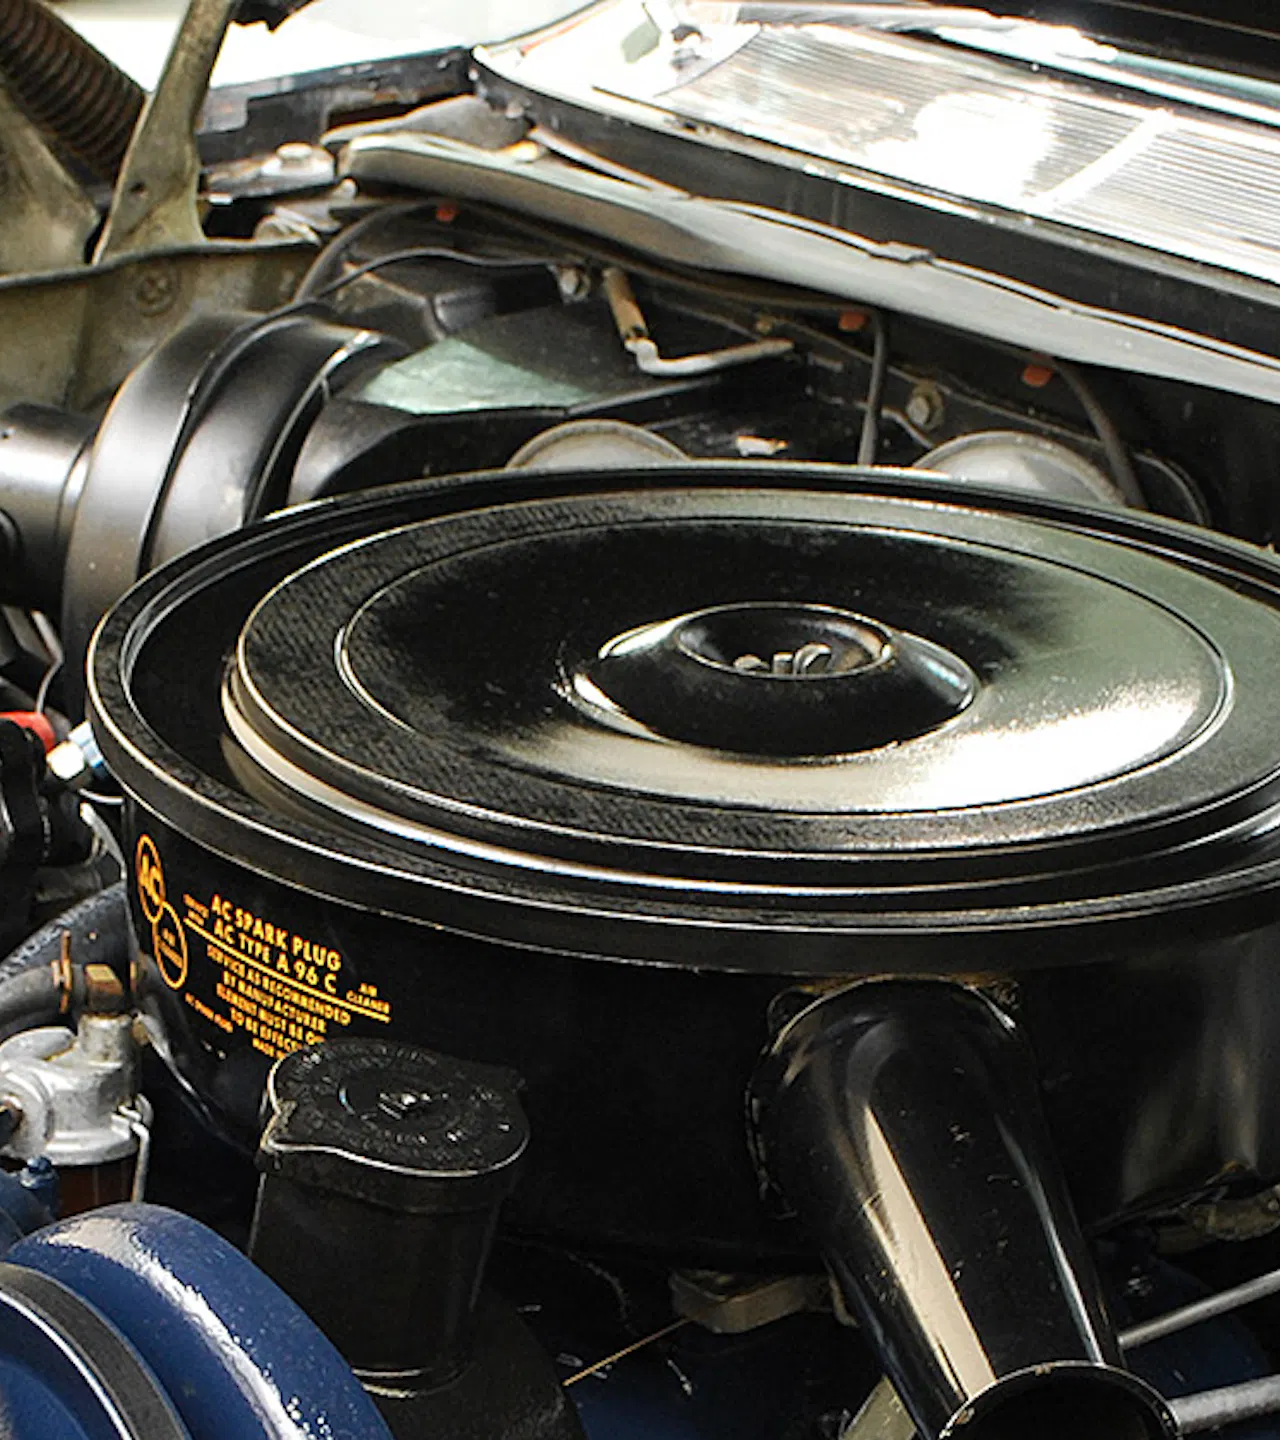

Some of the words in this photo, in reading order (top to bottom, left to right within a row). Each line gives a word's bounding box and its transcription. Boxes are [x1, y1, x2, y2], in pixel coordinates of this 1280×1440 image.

[211, 893, 233, 921] AC
[235, 907, 288, 952] SPARK
[292, 934, 342, 972] PLUG
[214, 917, 235, 945] AC
[238, 931, 271, 964] TYPE
[276, 951, 291, 974] A
[293, 959, 319, 986] 96
[323, 972, 337, 995] C
[262, 975, 351, 1026] RECOMMENDED
